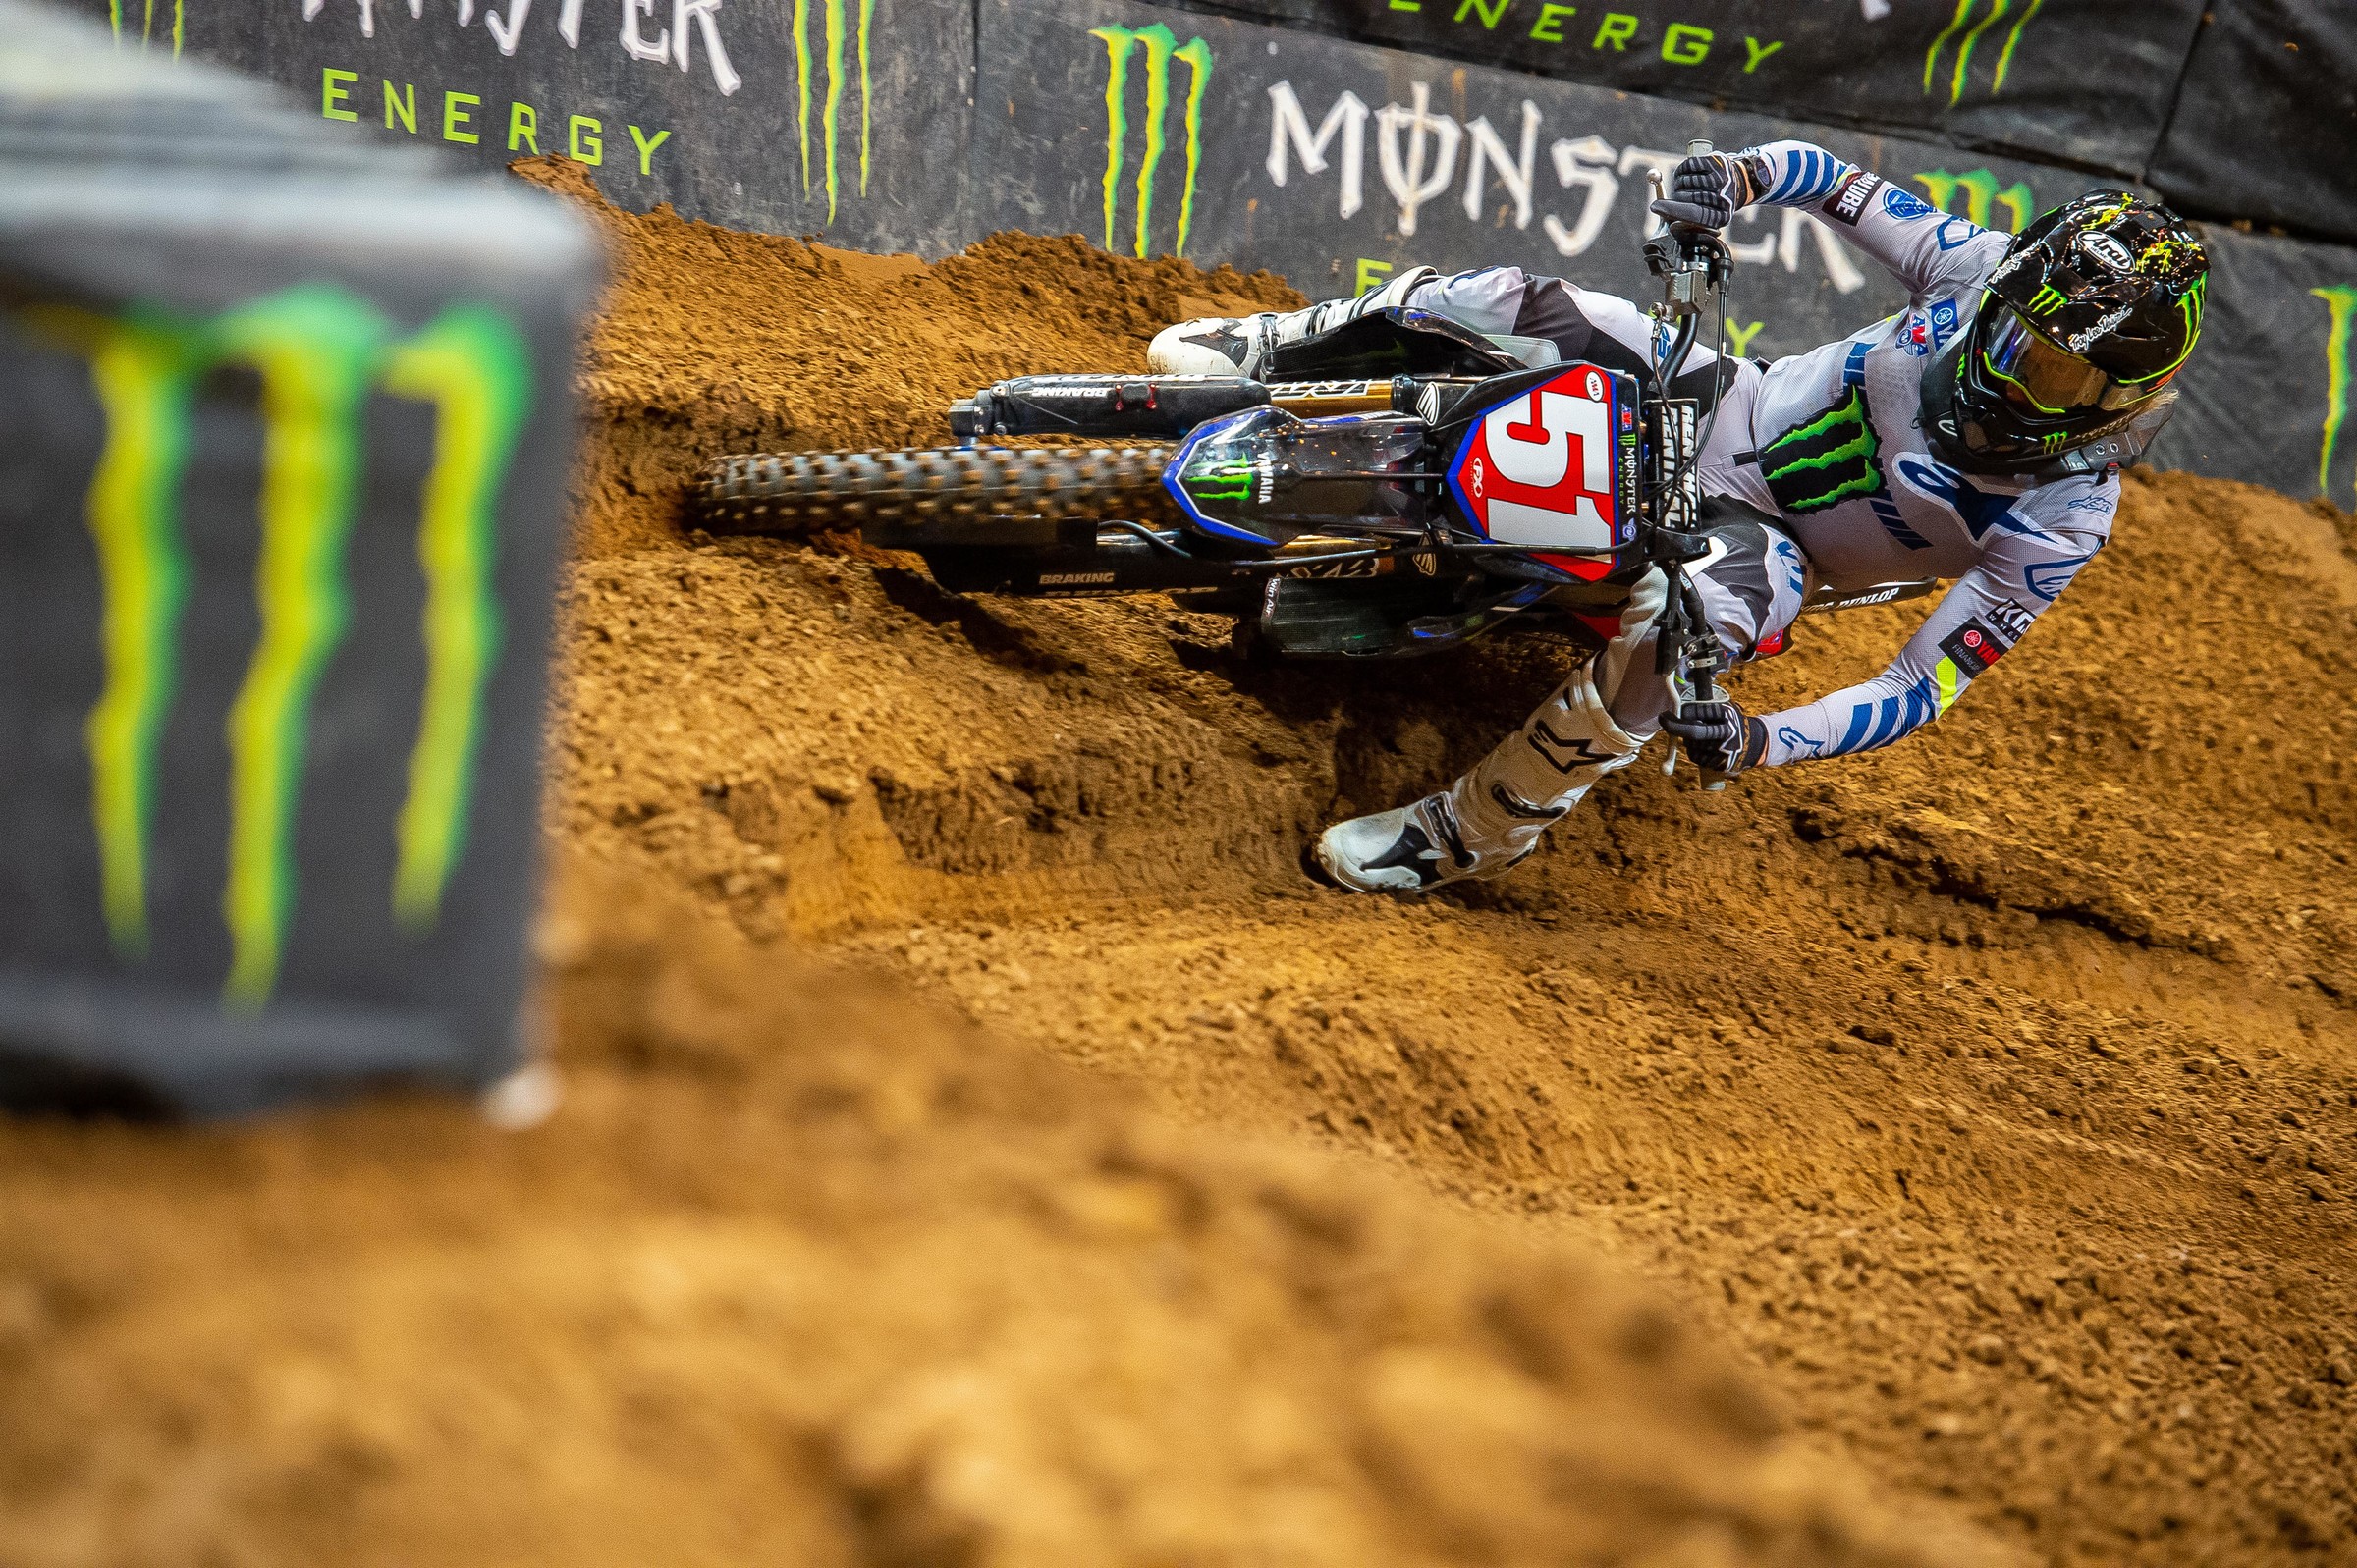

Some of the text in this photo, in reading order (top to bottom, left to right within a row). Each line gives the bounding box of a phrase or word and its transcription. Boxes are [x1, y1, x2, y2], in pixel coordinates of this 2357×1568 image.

[1388, 0, 1785, 74] NERGY
[322, 67, 672, 176] ENERGY
[2081, 238, 2131, 267] Arai
[1257, 451, 1276, 504] YAMAHA
[1485, 392, 1612, 564] 51
[1624, 447, 1638, 514] MONSTER
[1039, 572, 1115, 584] BRAKING
[1837, 587, 1900, 610] DUNLOP
